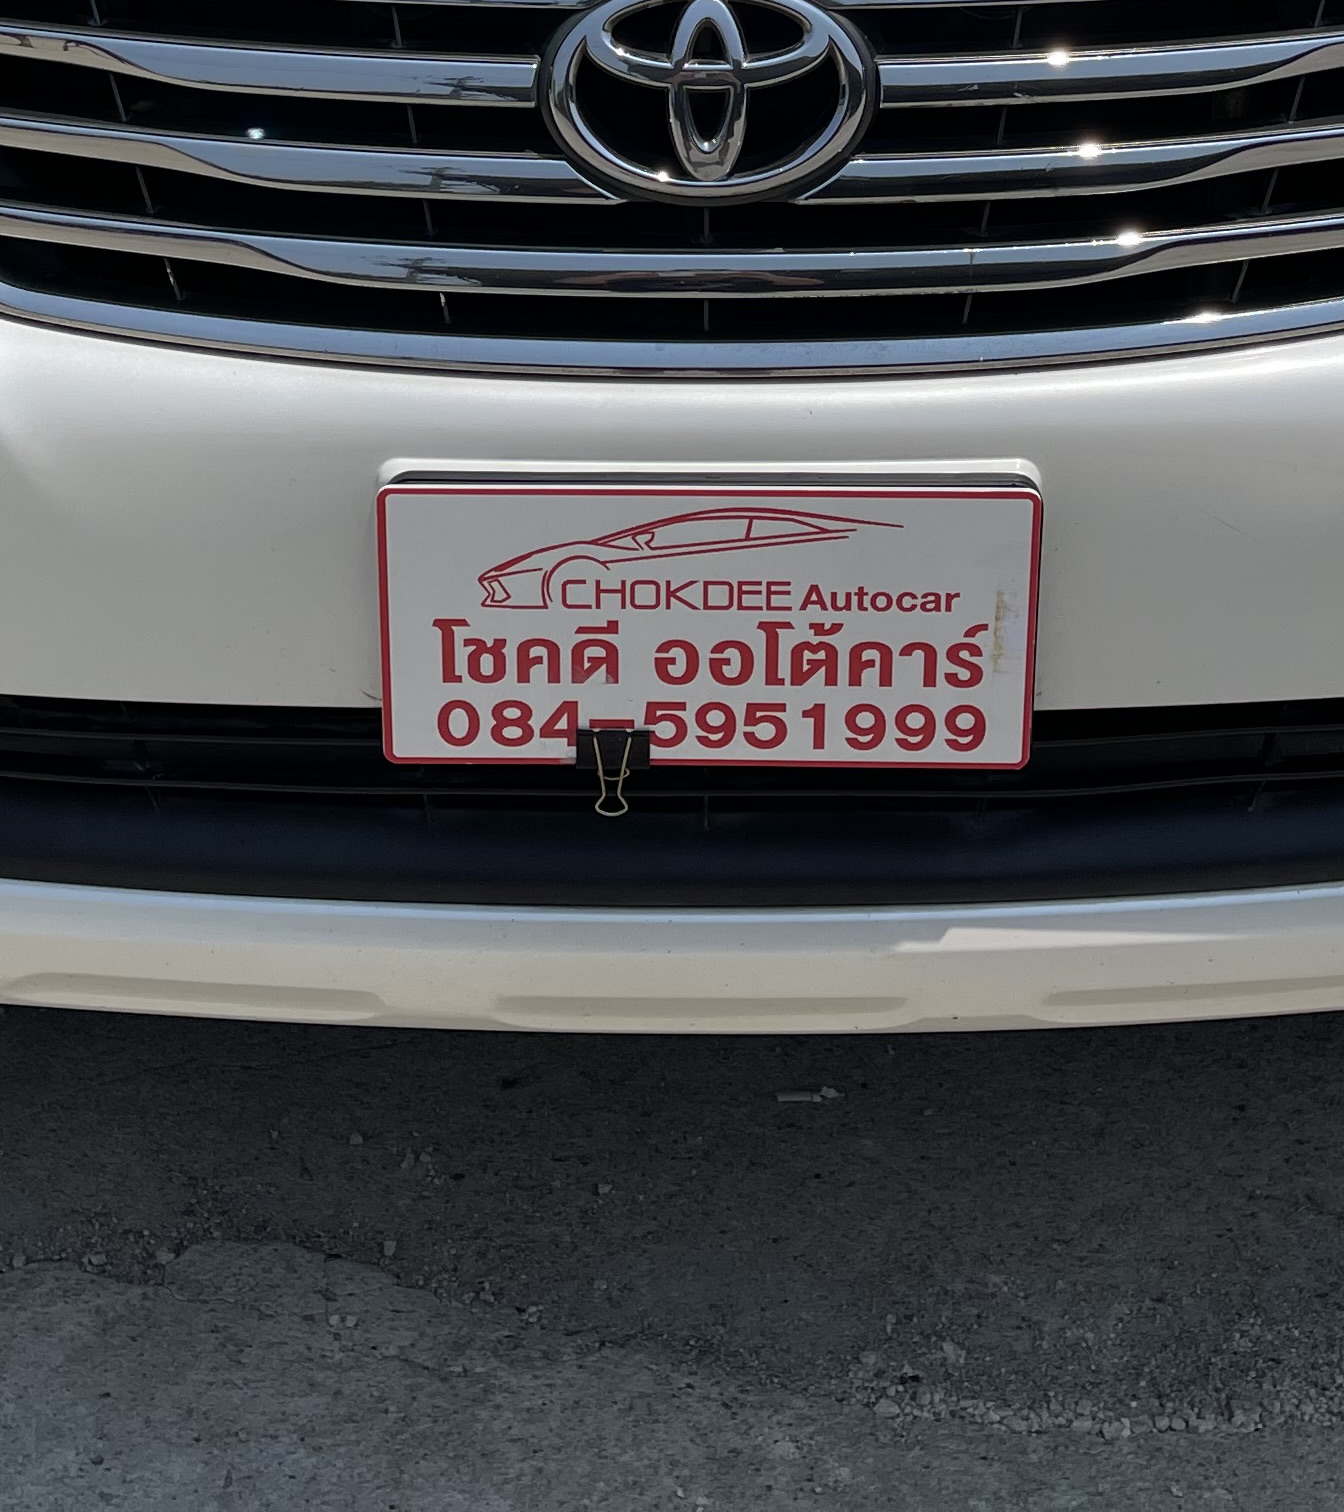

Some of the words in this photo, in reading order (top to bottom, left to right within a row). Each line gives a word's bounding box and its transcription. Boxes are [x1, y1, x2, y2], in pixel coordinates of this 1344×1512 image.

[561, 579, 792, 612] CHOKDEE
[799, 584, 960, 613] Autocar
[432, 618, 620, 684] โชคดี
[654, 620, 989, 689] ออโต้คาร์
[437, 699, 987, 753] 084-5951999
